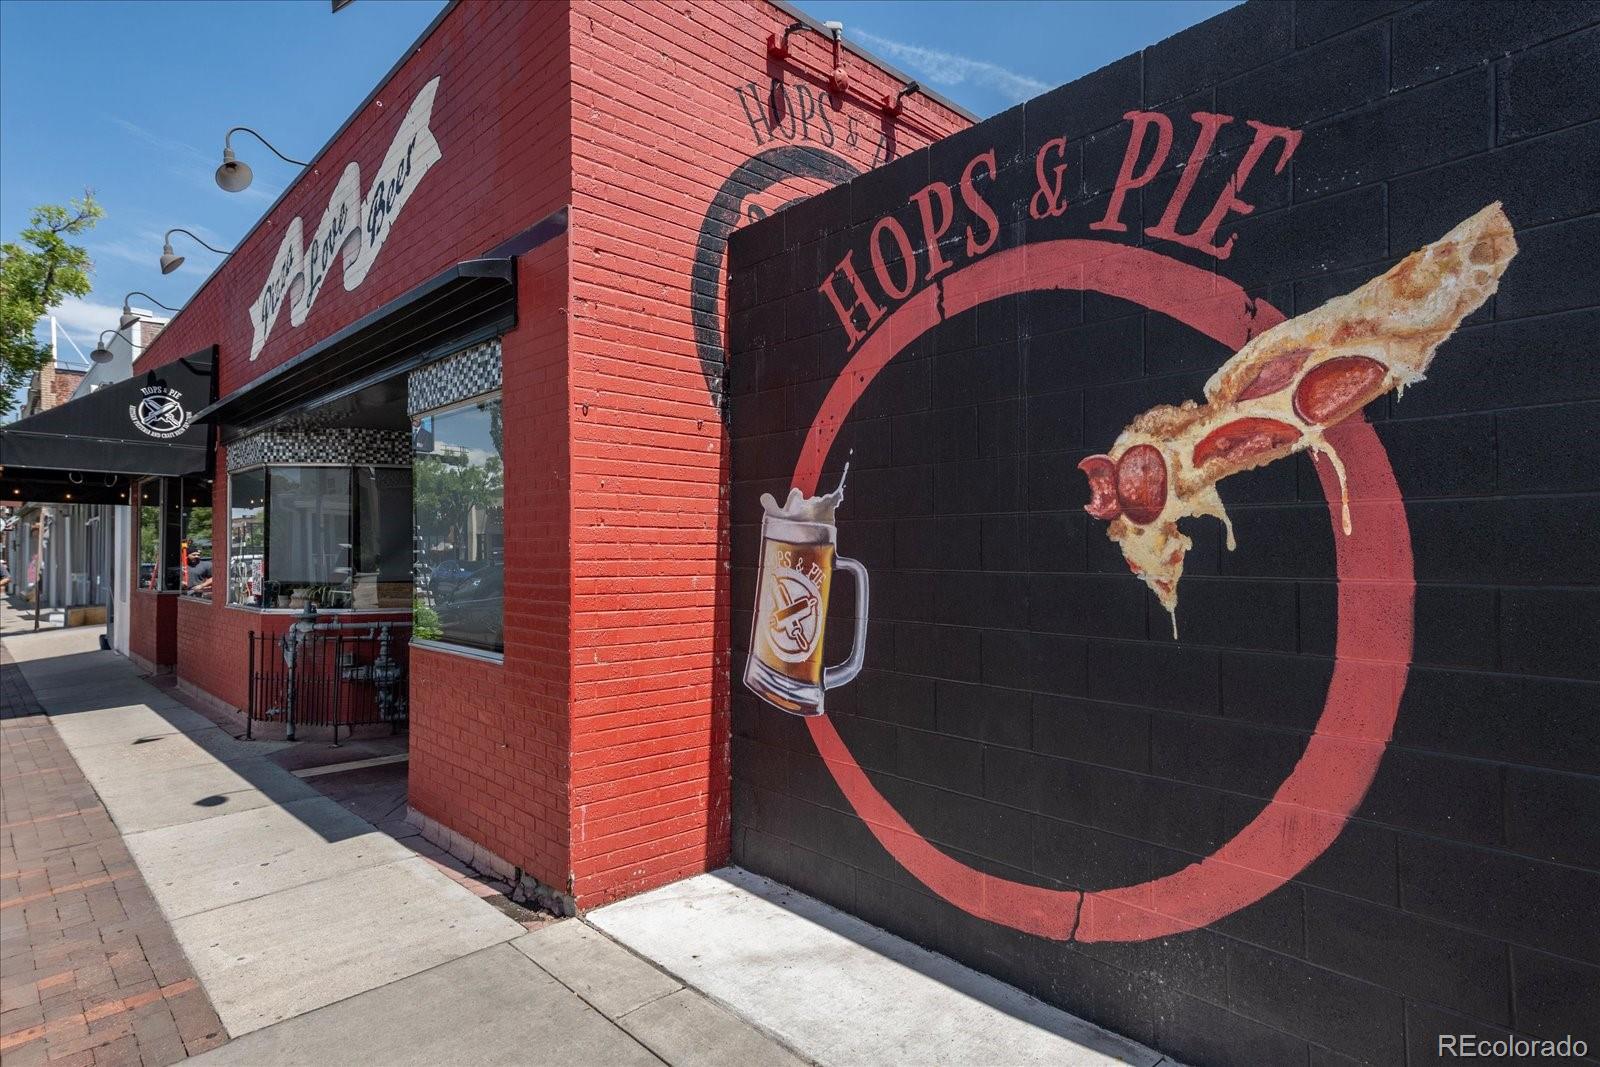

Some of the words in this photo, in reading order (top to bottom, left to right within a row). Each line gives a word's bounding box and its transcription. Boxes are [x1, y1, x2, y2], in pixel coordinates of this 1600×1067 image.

[735, 77, 835, 148] HOPS
[306, 202, 348, 308] Love
[367, 133, 418, 248] Beer
[817, 147, 1000, 352] HOPS
[1029, 136, 1069, 219] &
[1089, 110, 1303, 260] PIE
[140, 386, 162, 396] HOPS
[168, 388, 183, 399] PIE
[795, 557, 804, 572] &
[806, 562, 826, 589] PIE
